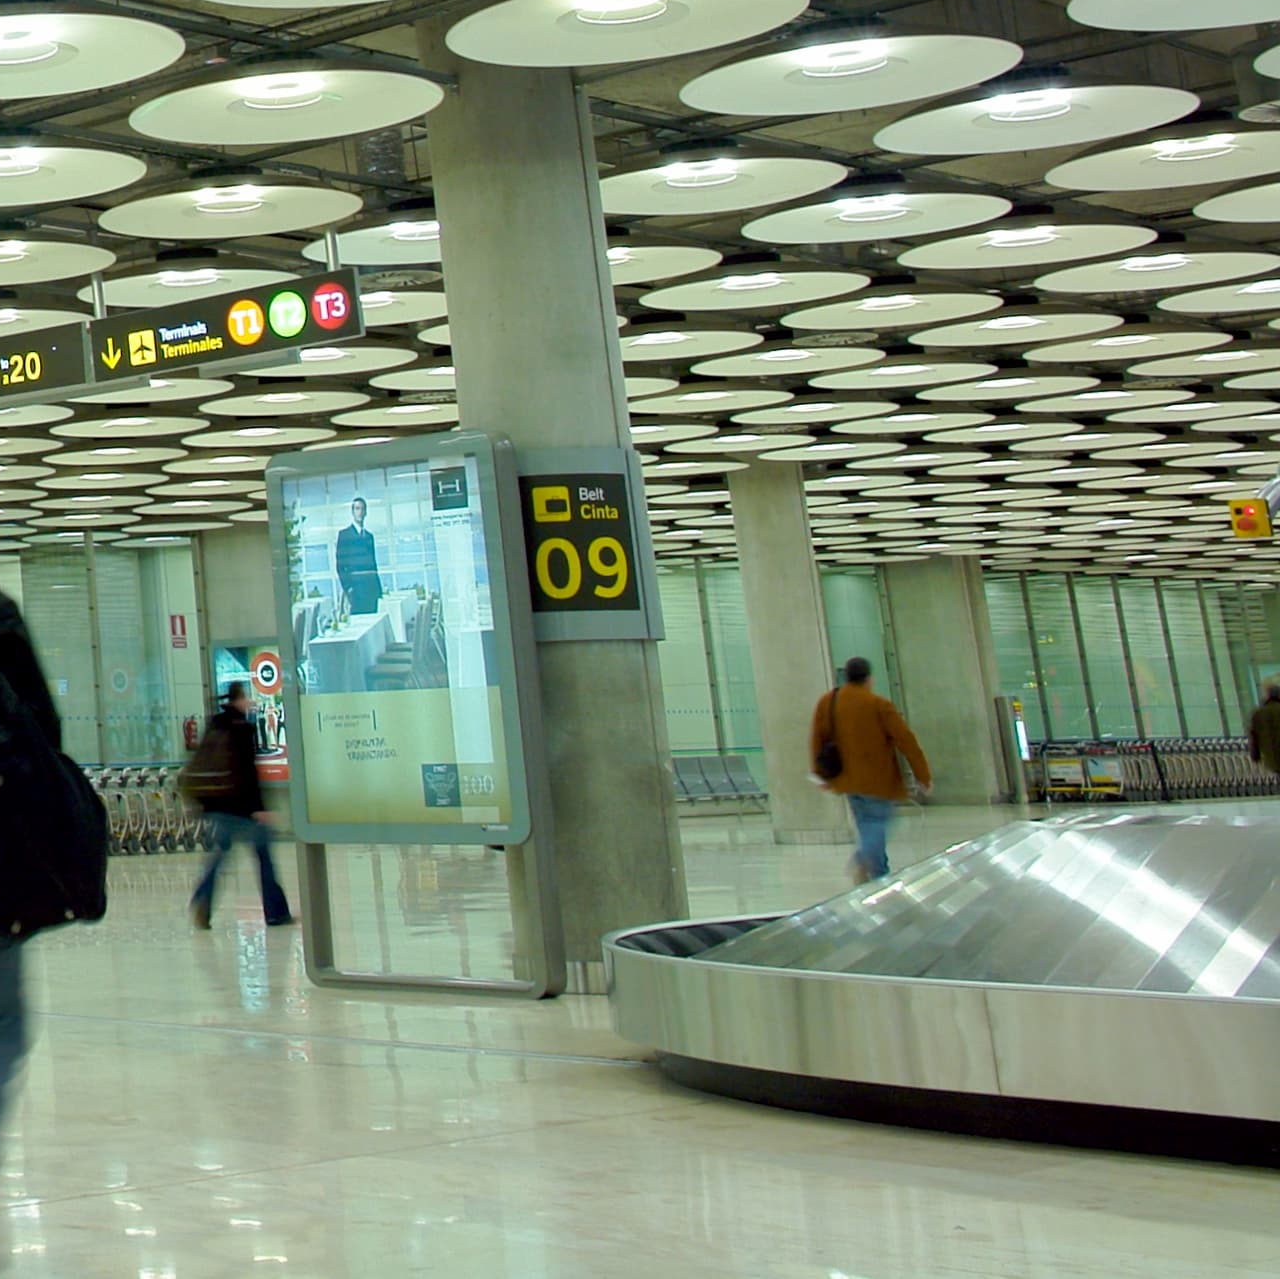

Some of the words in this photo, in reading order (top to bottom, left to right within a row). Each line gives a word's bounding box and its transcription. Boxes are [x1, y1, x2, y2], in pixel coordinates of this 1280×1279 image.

[231, 309, 261, 336] T1
[273, 301, 303, 328] T2
[315, 291, 346, 320] T3
[159, 321, 207, 342] Terminals
[161, 336, 223, 359] Terminales
[10, 352, 41, 383] 20
[579, 487, 605, 501] Belt
[580, 504, 619, 519] Cinta
[535, 536, 628, 599] 09
